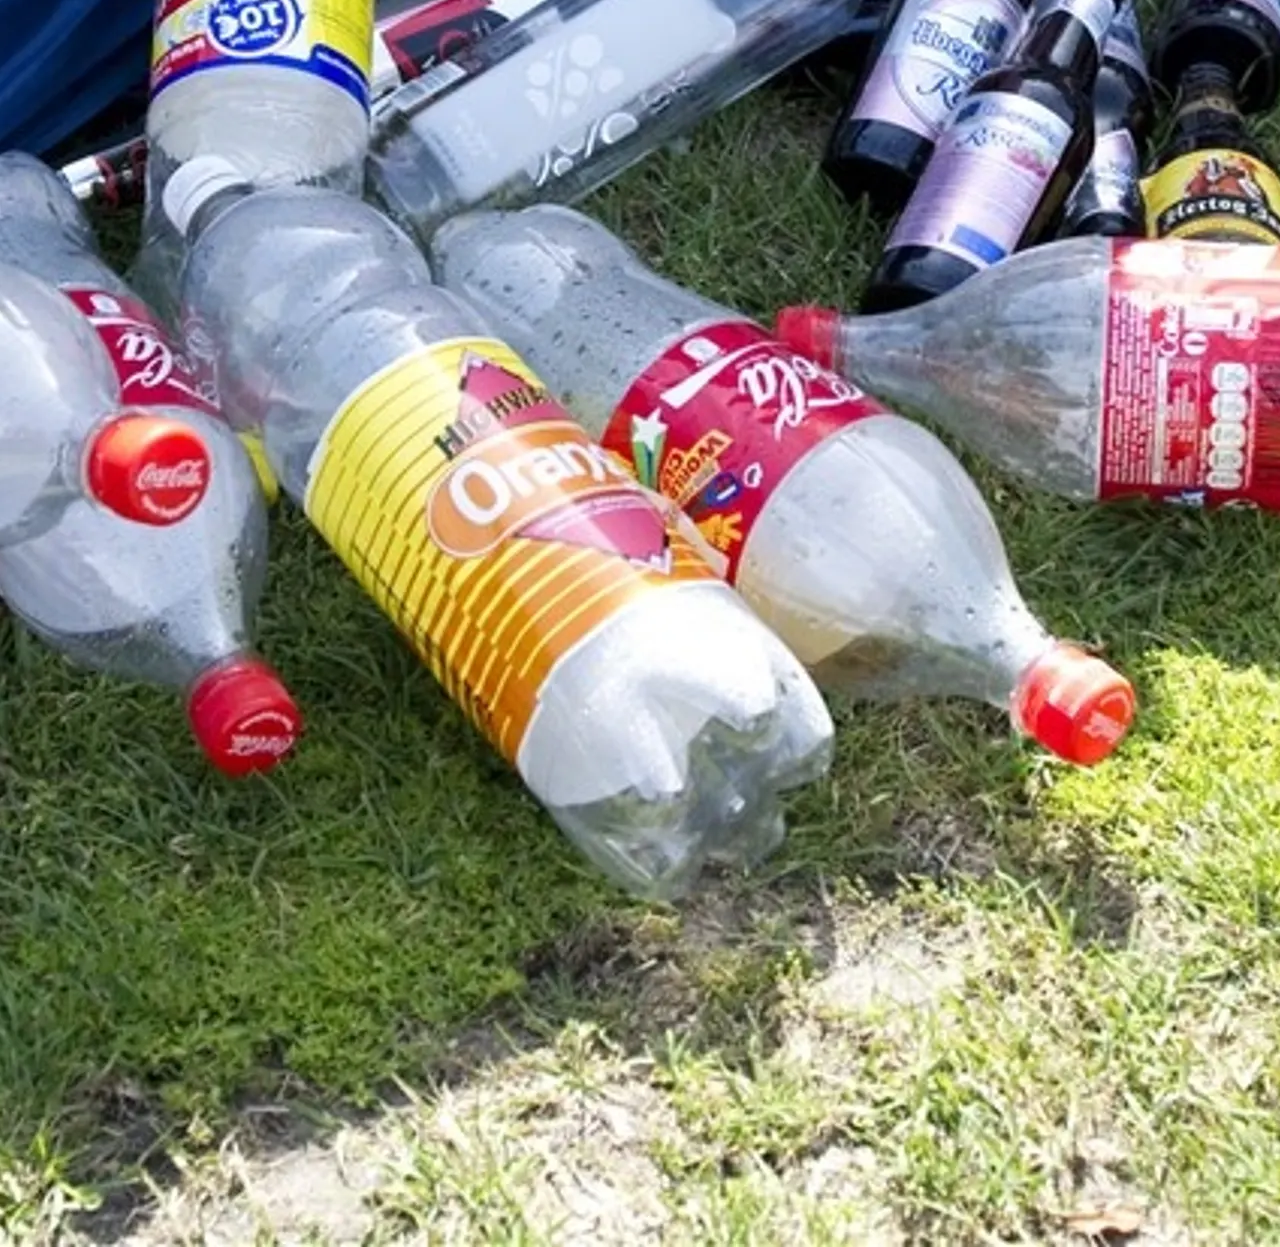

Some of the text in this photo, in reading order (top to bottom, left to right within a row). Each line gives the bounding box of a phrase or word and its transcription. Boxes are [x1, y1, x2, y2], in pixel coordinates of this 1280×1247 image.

[215, 2, 284, 40] 10€
[911, 19, 991, 78] Hoega
[916, 75, 966, 111] Ro
[1164, 196, 1247, 230] Hertog
[434, 385, 552, 463] HIGHWA
